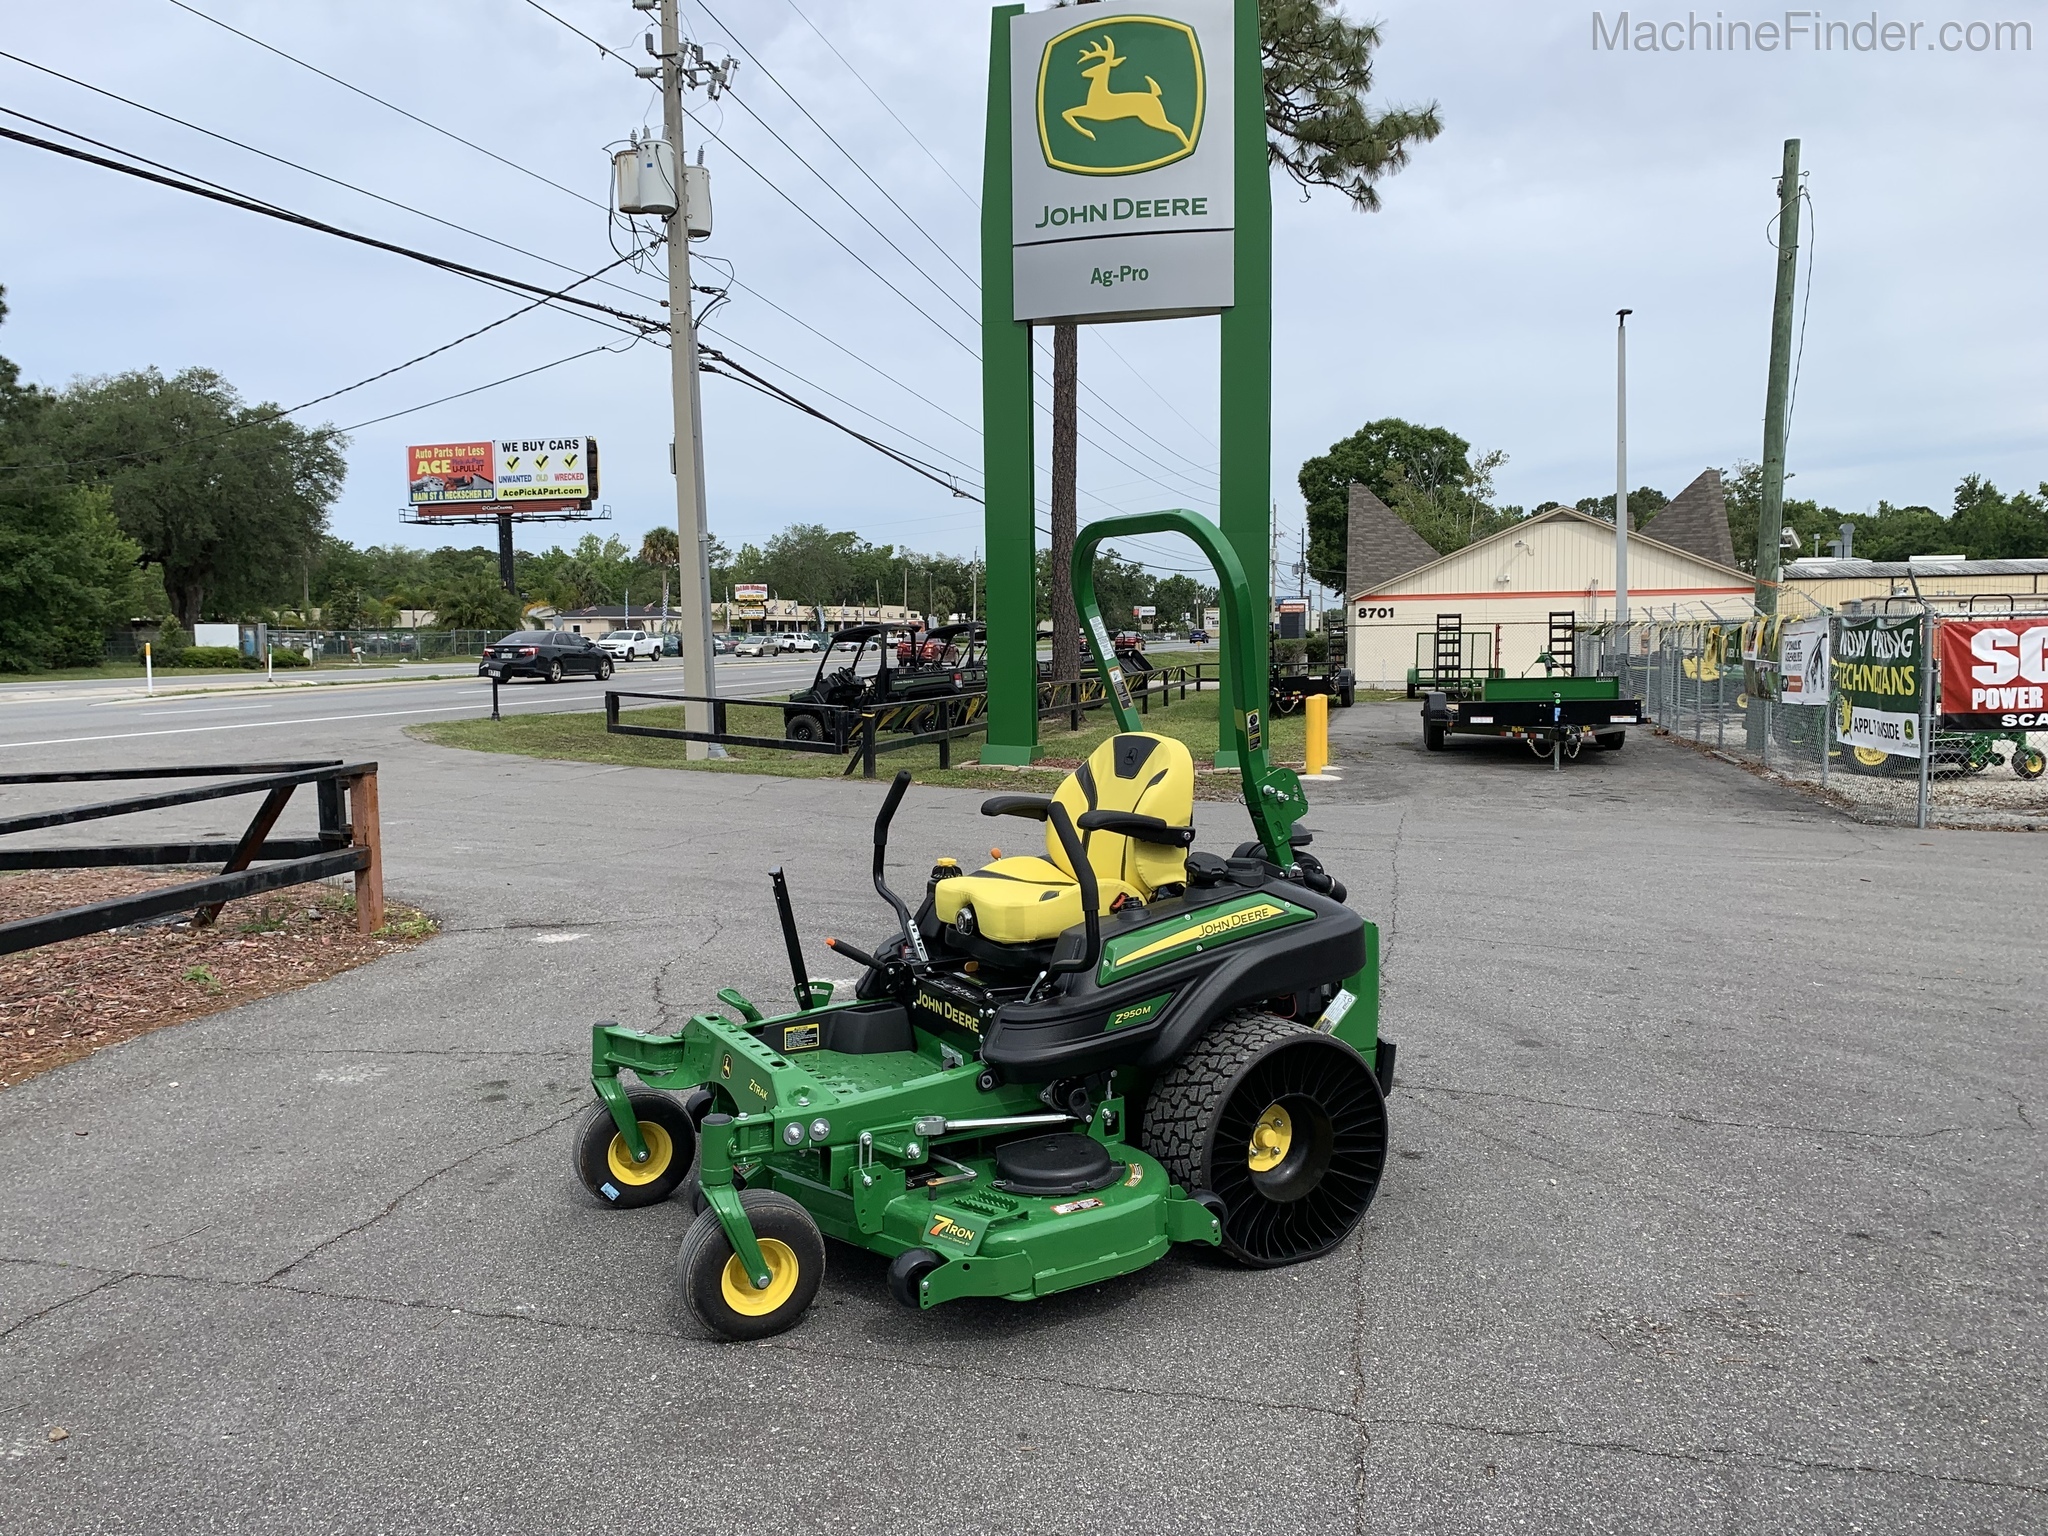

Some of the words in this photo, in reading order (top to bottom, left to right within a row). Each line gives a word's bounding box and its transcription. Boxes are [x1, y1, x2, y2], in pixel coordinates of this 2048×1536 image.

[1035, 203, 1107, 228] JOHN
[1113, 197, 1208, 220] DEERE
[1090, 265, 1149, 287] Ag-Pro
[415, 448, 432, 459] Auto
[434, 447, 453, 458] Parts
[455, 446, 466, 456] for
[467, 446, 485, 456] Less
[501, 442, 518, 452] WE
[522, 440, 545, 451] BUY
[549, 439, 579, 450] CARS
[416, 460, 451, 475] ACE
[498, 474, 532, 483] UNWANTED
[535, 473, 548, 482] OLD
[554, 472, 584, 481] WRECKED
[412, 492, 428, 501] MAIN
[429, 491, 437, 501] ST
[483, 489, 492, 498] DR
[502, 487, 582, 497] AcePickAPart.com
[1358, 607, 1394, 619] 8701
[1972, 686, 2044, 710] POWER
[1199, 919, 1230, 937] JOHN
[1231, 908, 1269, 926] DEERE
[916, 989, 943, 1015] JOHN
[944, 1001, 980, 1033] DEERE
[1114, 1005, 1152, 1024] Z950M
[749, 1078, 769, 1101] ZTRAK
